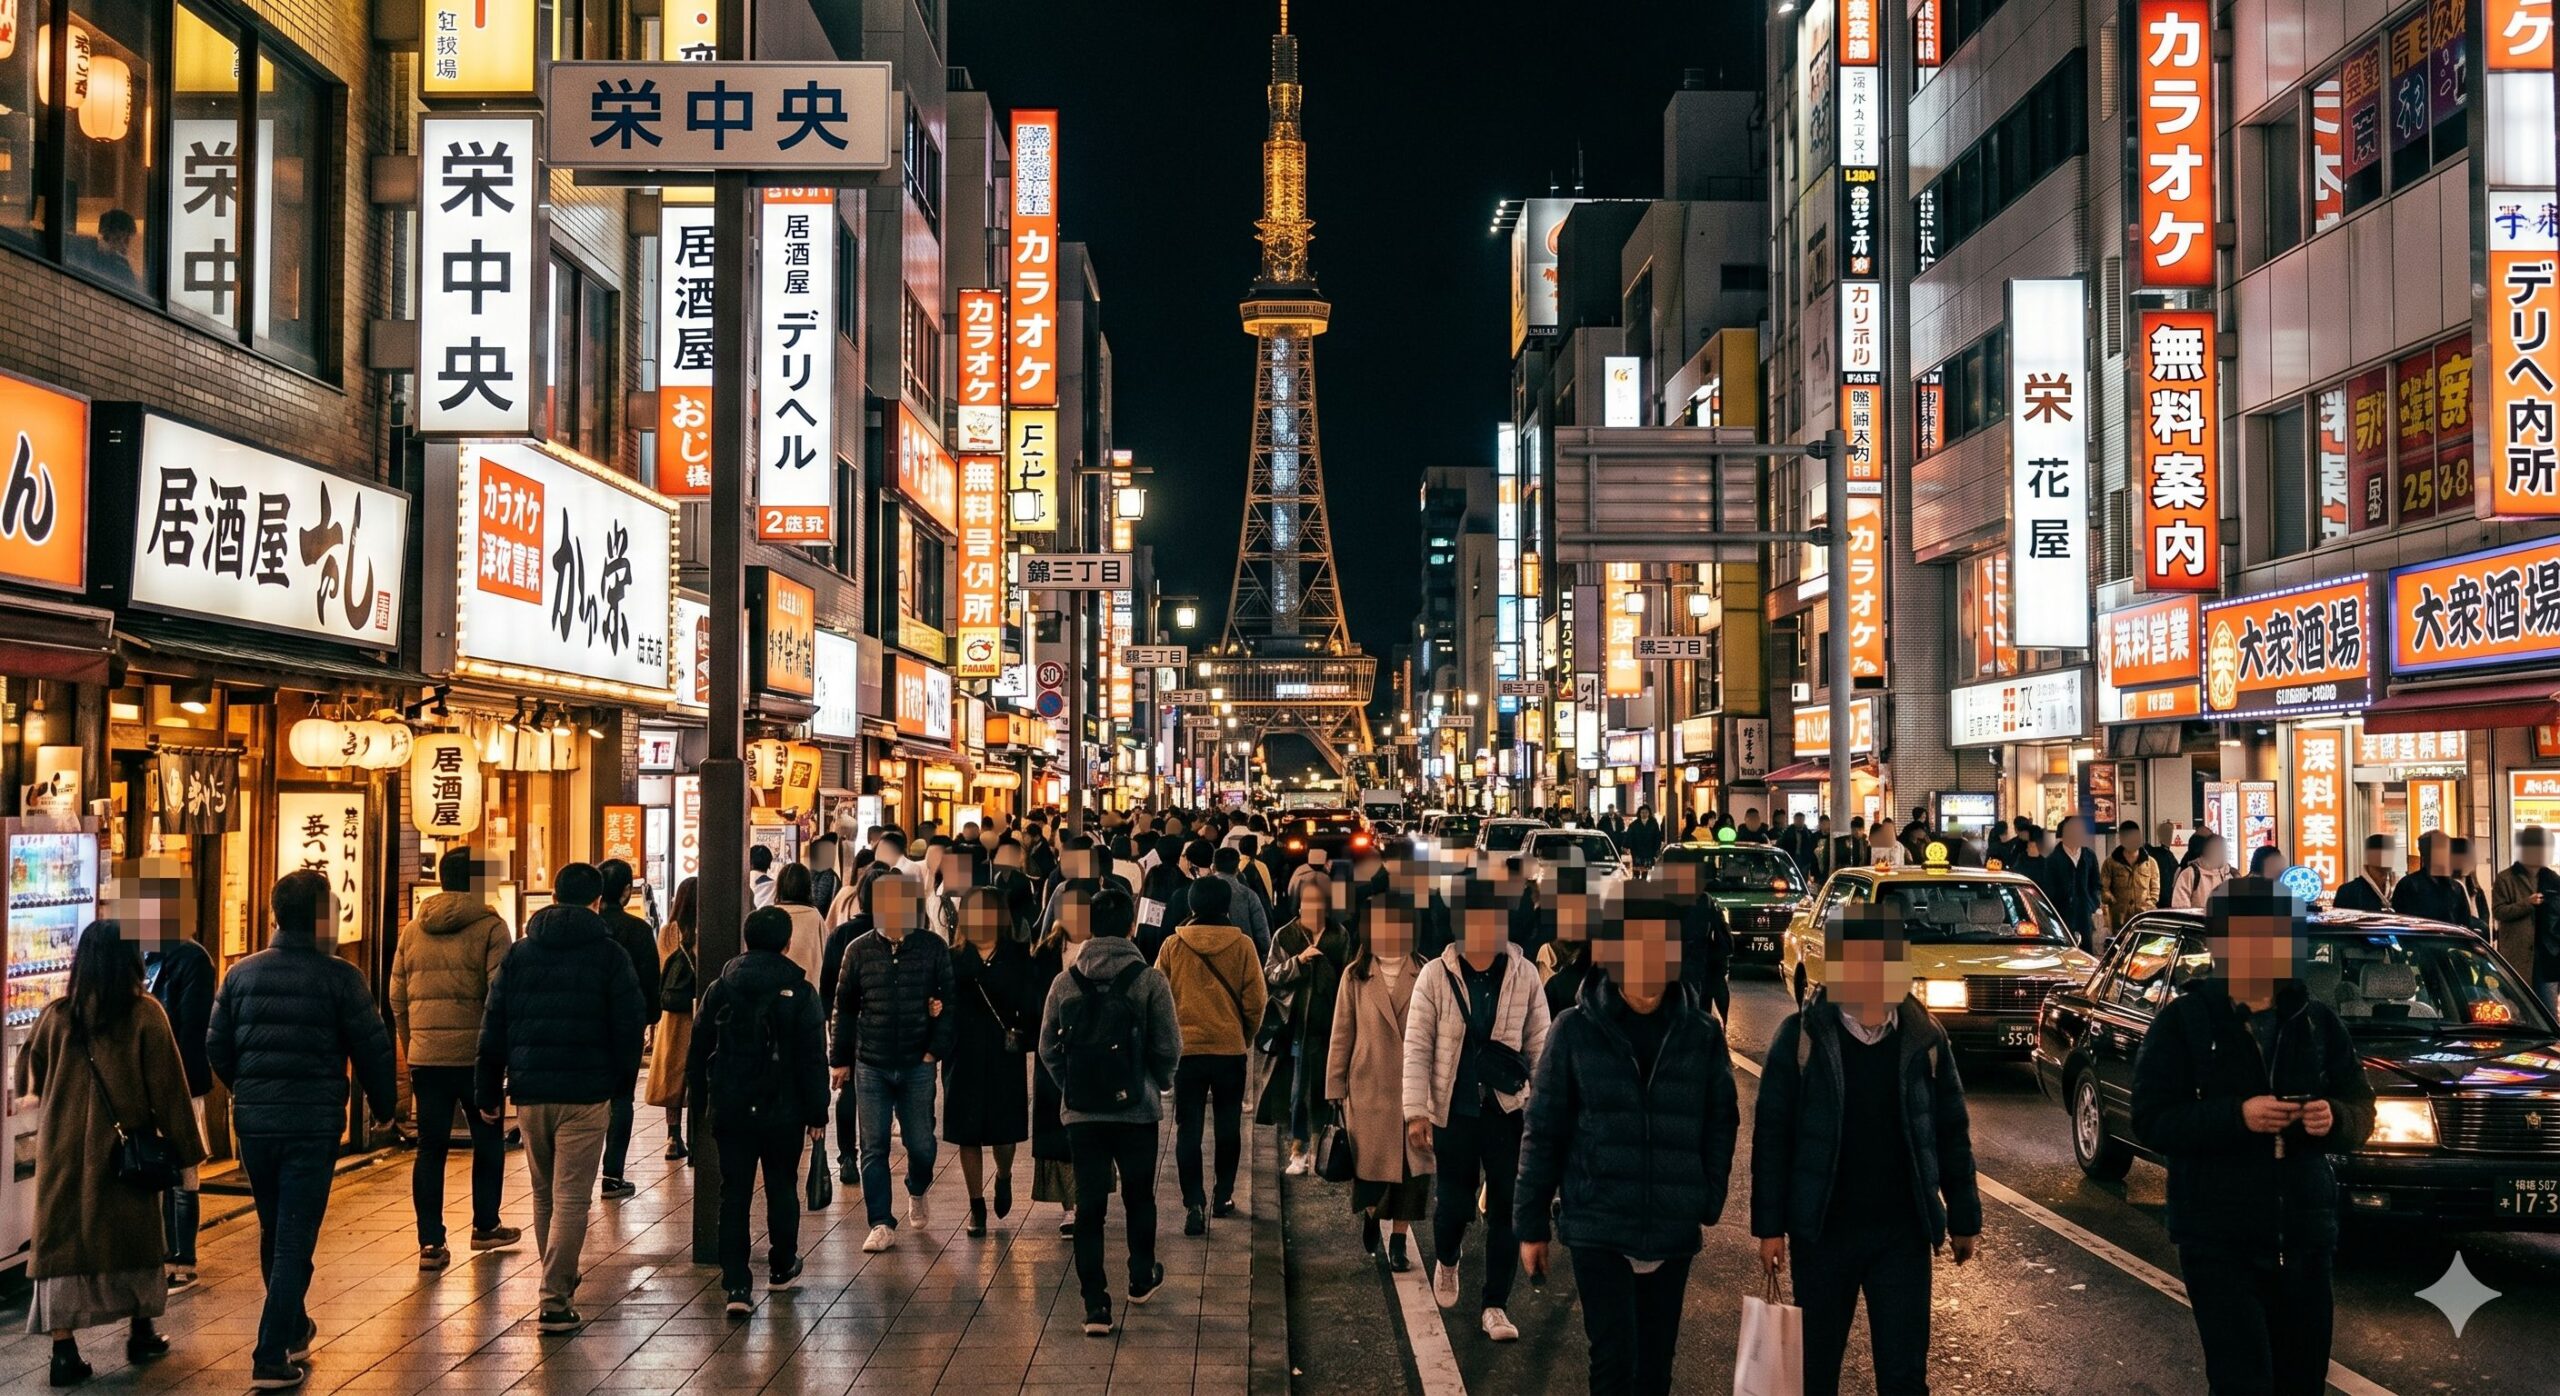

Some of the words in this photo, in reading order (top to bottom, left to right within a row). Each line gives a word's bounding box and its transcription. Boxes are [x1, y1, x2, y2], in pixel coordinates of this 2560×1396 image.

[589, 78, 849, 151] 栄中央
[2148, 12, 2204, 267] カラオケ
[437, 140, 515, 412] 栄中央
[674, 226, 714, 369] 居酒屋
[784, 214, 811, 294] 居酒屋
[1016, 229, 1051, 391] カラオケ
[775, 310, 819, 470] デリヘル
[966, 298, 996, 402] カラオケ
[2508, 263, 2556, 492] デリヘ内所
[2, 431, 55, 545] ん
[483, 475, 541, 535] カラオケ
[2023, 372, 2073, 559] 栄花屋
[2150, 324, 2206, 577] 無料案内
[147, 466, 292, 589] 居酒屋
[1850, 525, 1877, 648] カラオケ
[2239, 598, 2359, 679] 大衆酒場
[2414, 561, 2560, 650] 大衆酒場
[431, 746, 464, 827] 居酒屋
